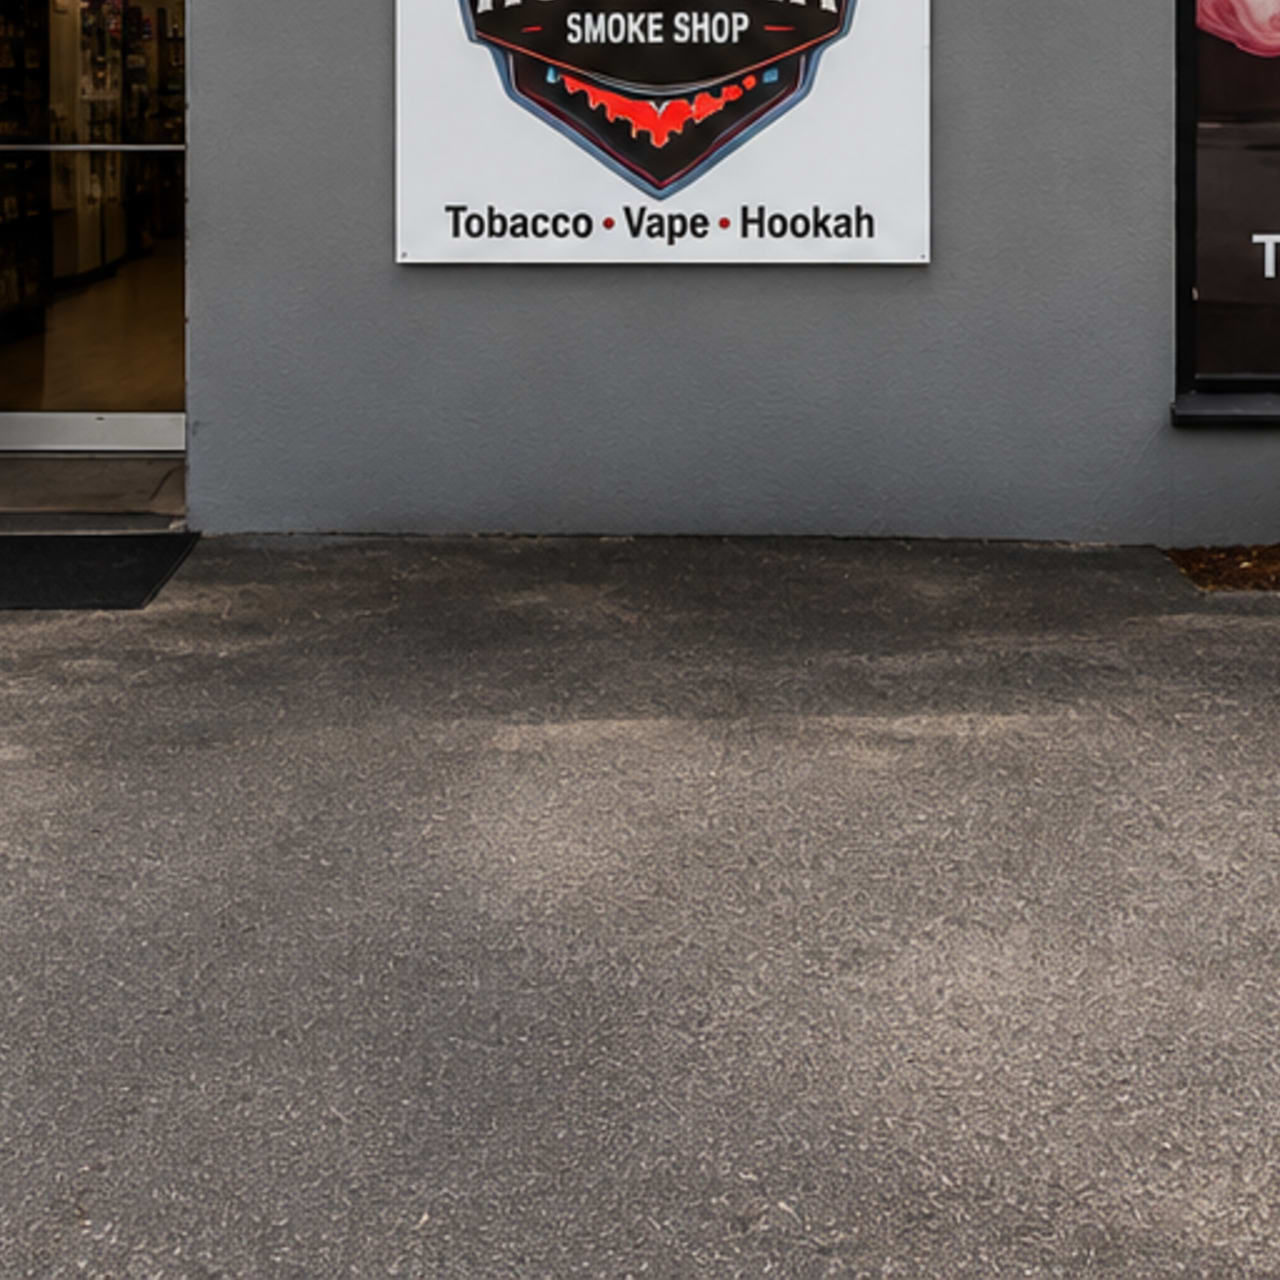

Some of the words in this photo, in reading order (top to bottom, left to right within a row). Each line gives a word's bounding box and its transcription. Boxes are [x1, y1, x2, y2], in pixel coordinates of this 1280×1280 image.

[567, 12, 664, 44] SMOKE
[673, 12, 749, 43] SHOP
[444, 205, 593, 239] Tobacco
[623, 206, 710, 246] Vape
[741, 205, 874, 239] Hookah
